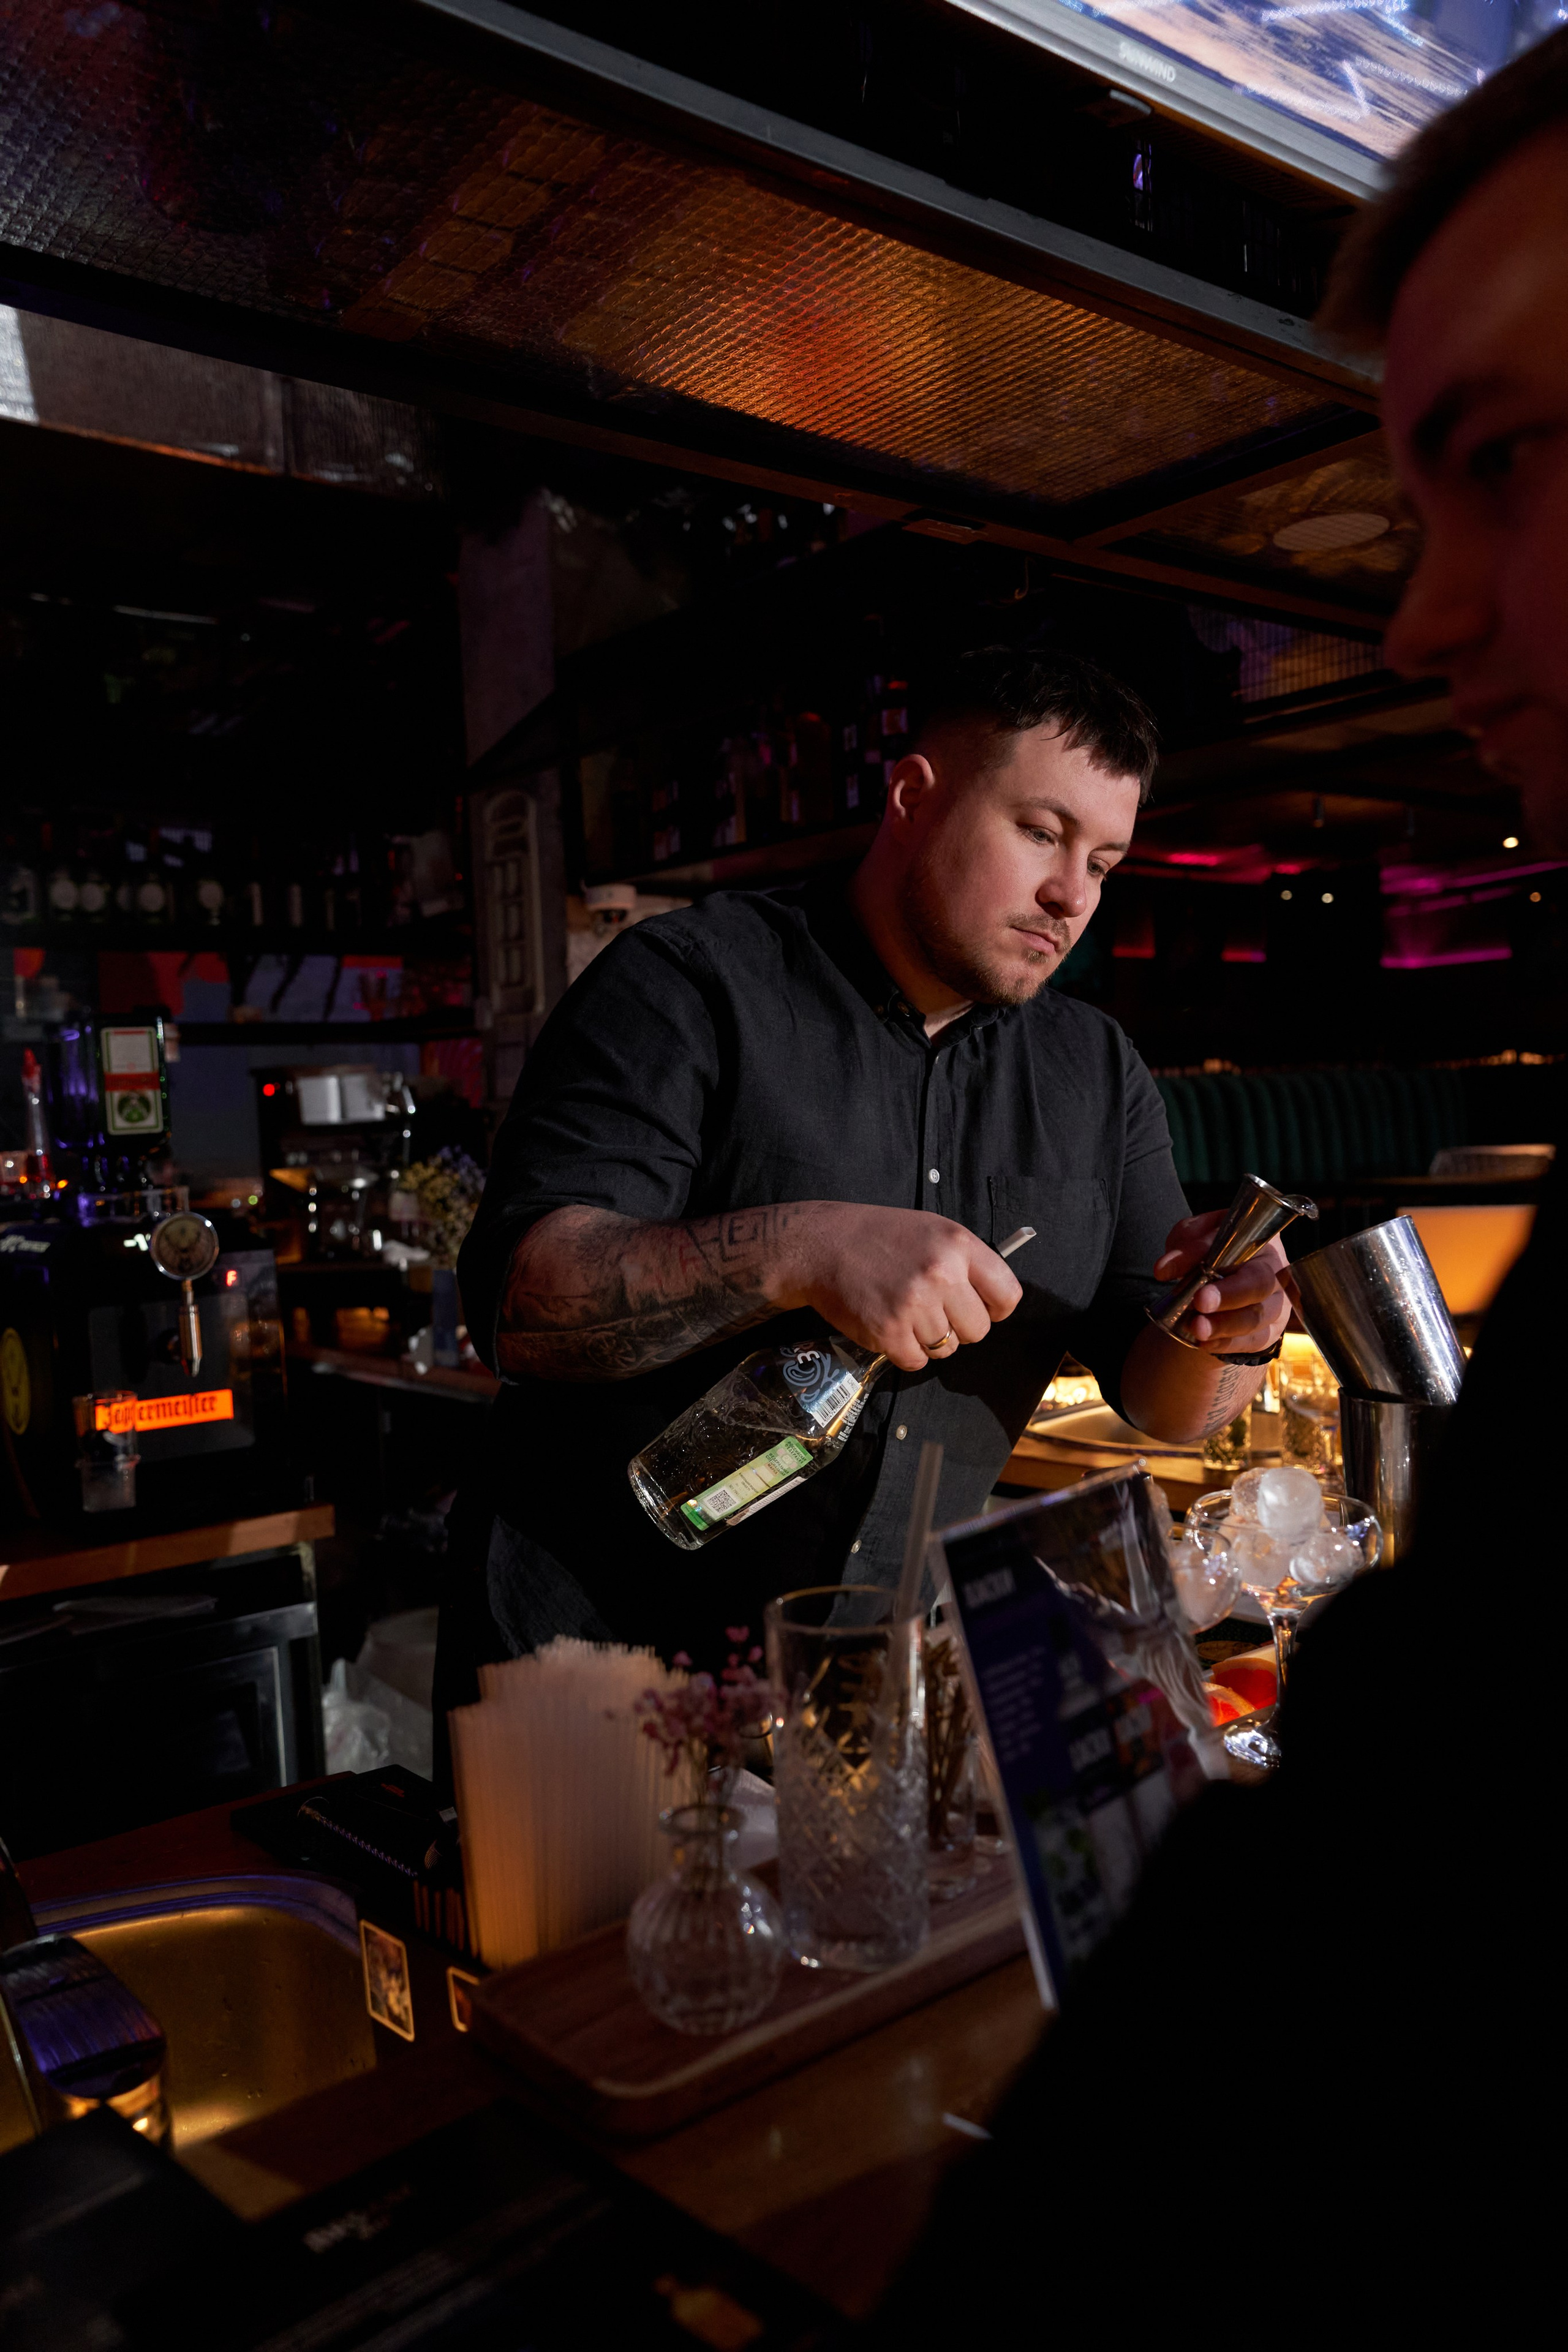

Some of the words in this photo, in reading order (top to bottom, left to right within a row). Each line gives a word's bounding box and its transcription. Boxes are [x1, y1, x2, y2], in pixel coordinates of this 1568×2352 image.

[785, 1444, 805, 1464] ФЕДЕРАЦИЯ
[787, 1441, 807, 1461] РОССИЙСКАЯ
[767, 1463, 778, 1475] МАРКА
